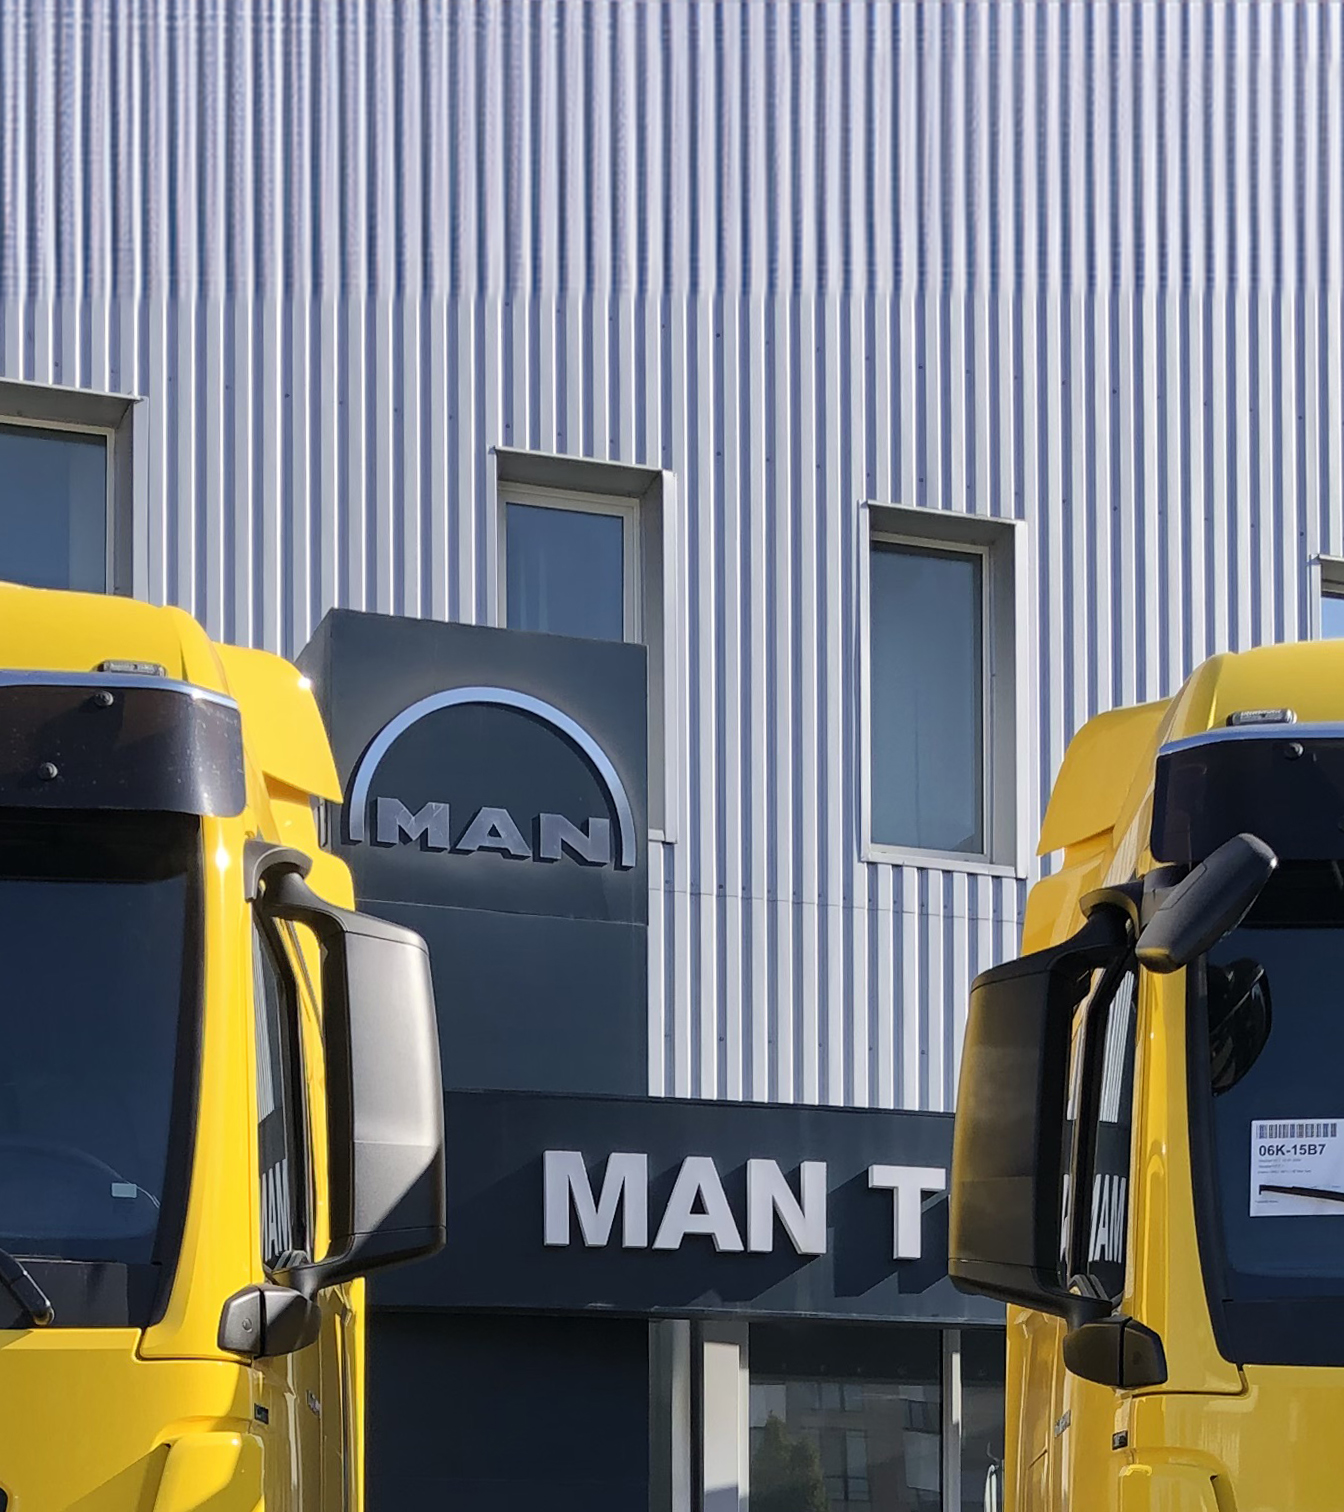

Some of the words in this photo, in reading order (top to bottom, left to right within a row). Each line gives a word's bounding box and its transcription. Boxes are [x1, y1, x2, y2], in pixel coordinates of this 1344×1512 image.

[374, 797, 610, 864] MAN
[1258, 1144, 1326, 1156] 06K-15B7
[542, 1150, 828, 1255] MAN
[868, 1165, 948, 1261] T
